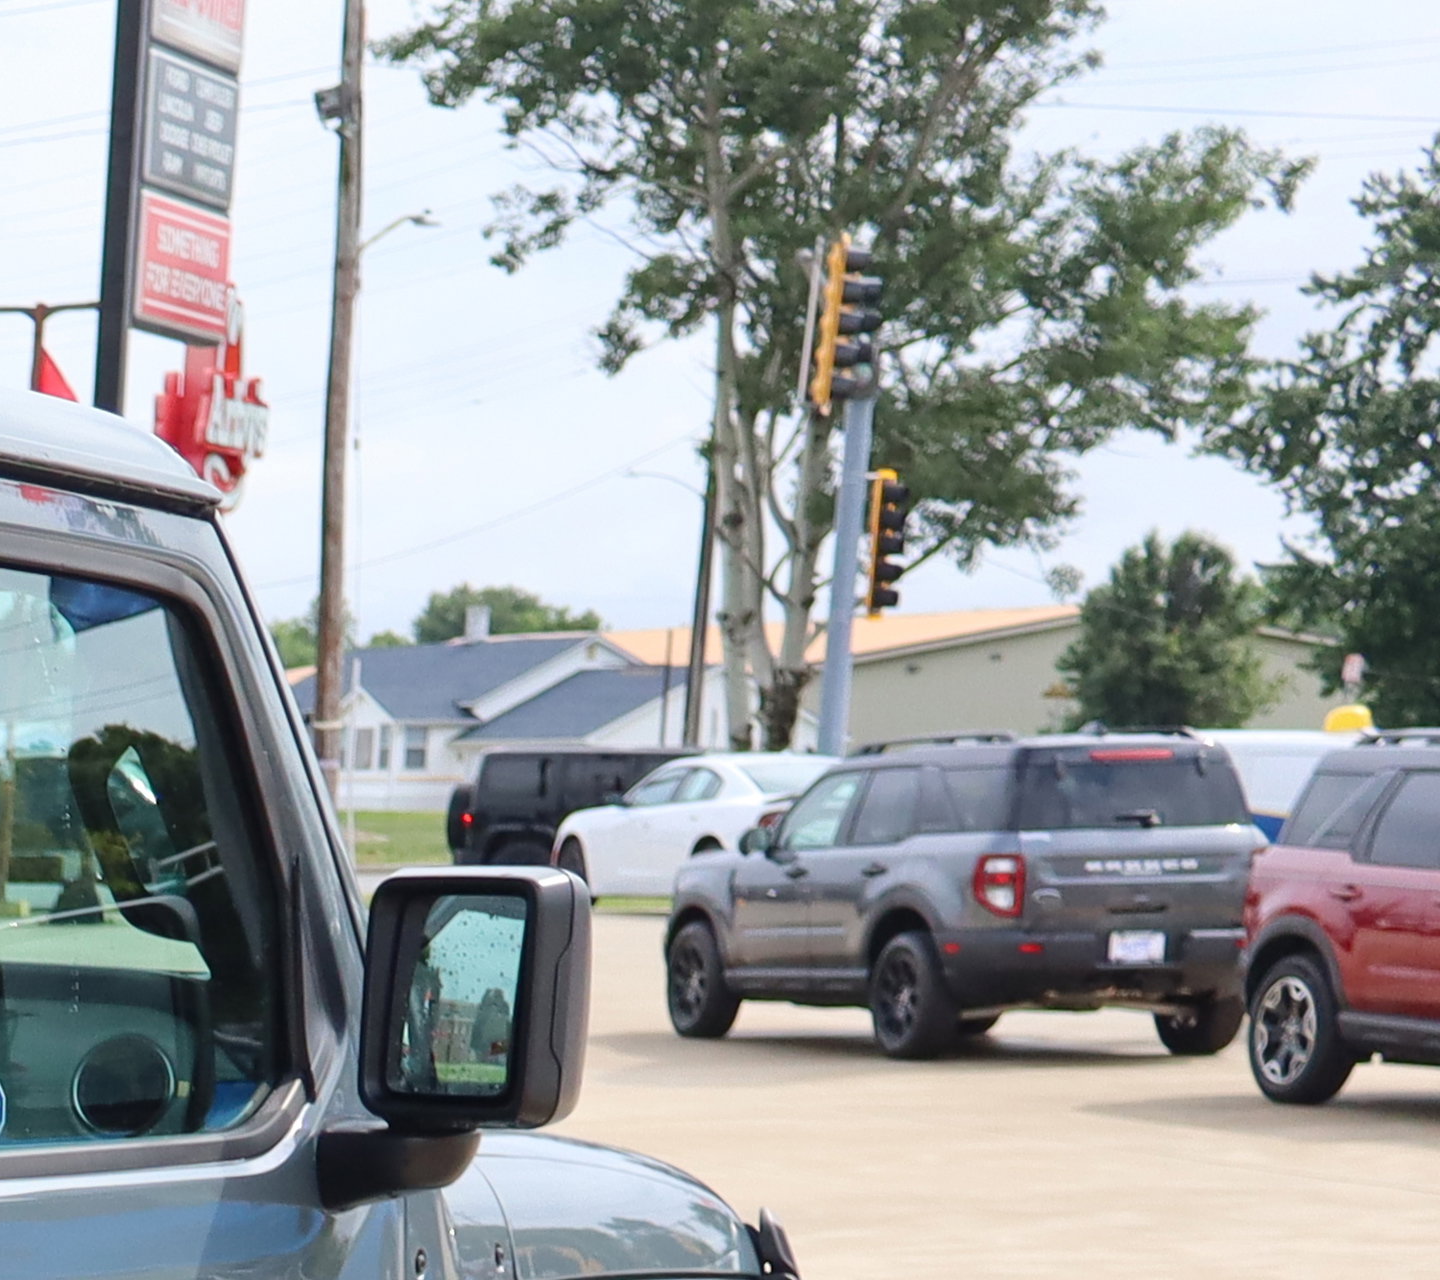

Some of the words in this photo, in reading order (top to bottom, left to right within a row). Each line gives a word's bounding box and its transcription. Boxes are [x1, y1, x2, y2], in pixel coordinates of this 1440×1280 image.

[157, 223, 220, 269] SOMETHING
[145, 261, 170, 294] FOR
[170, 268, 226, 312] EVERYONE
